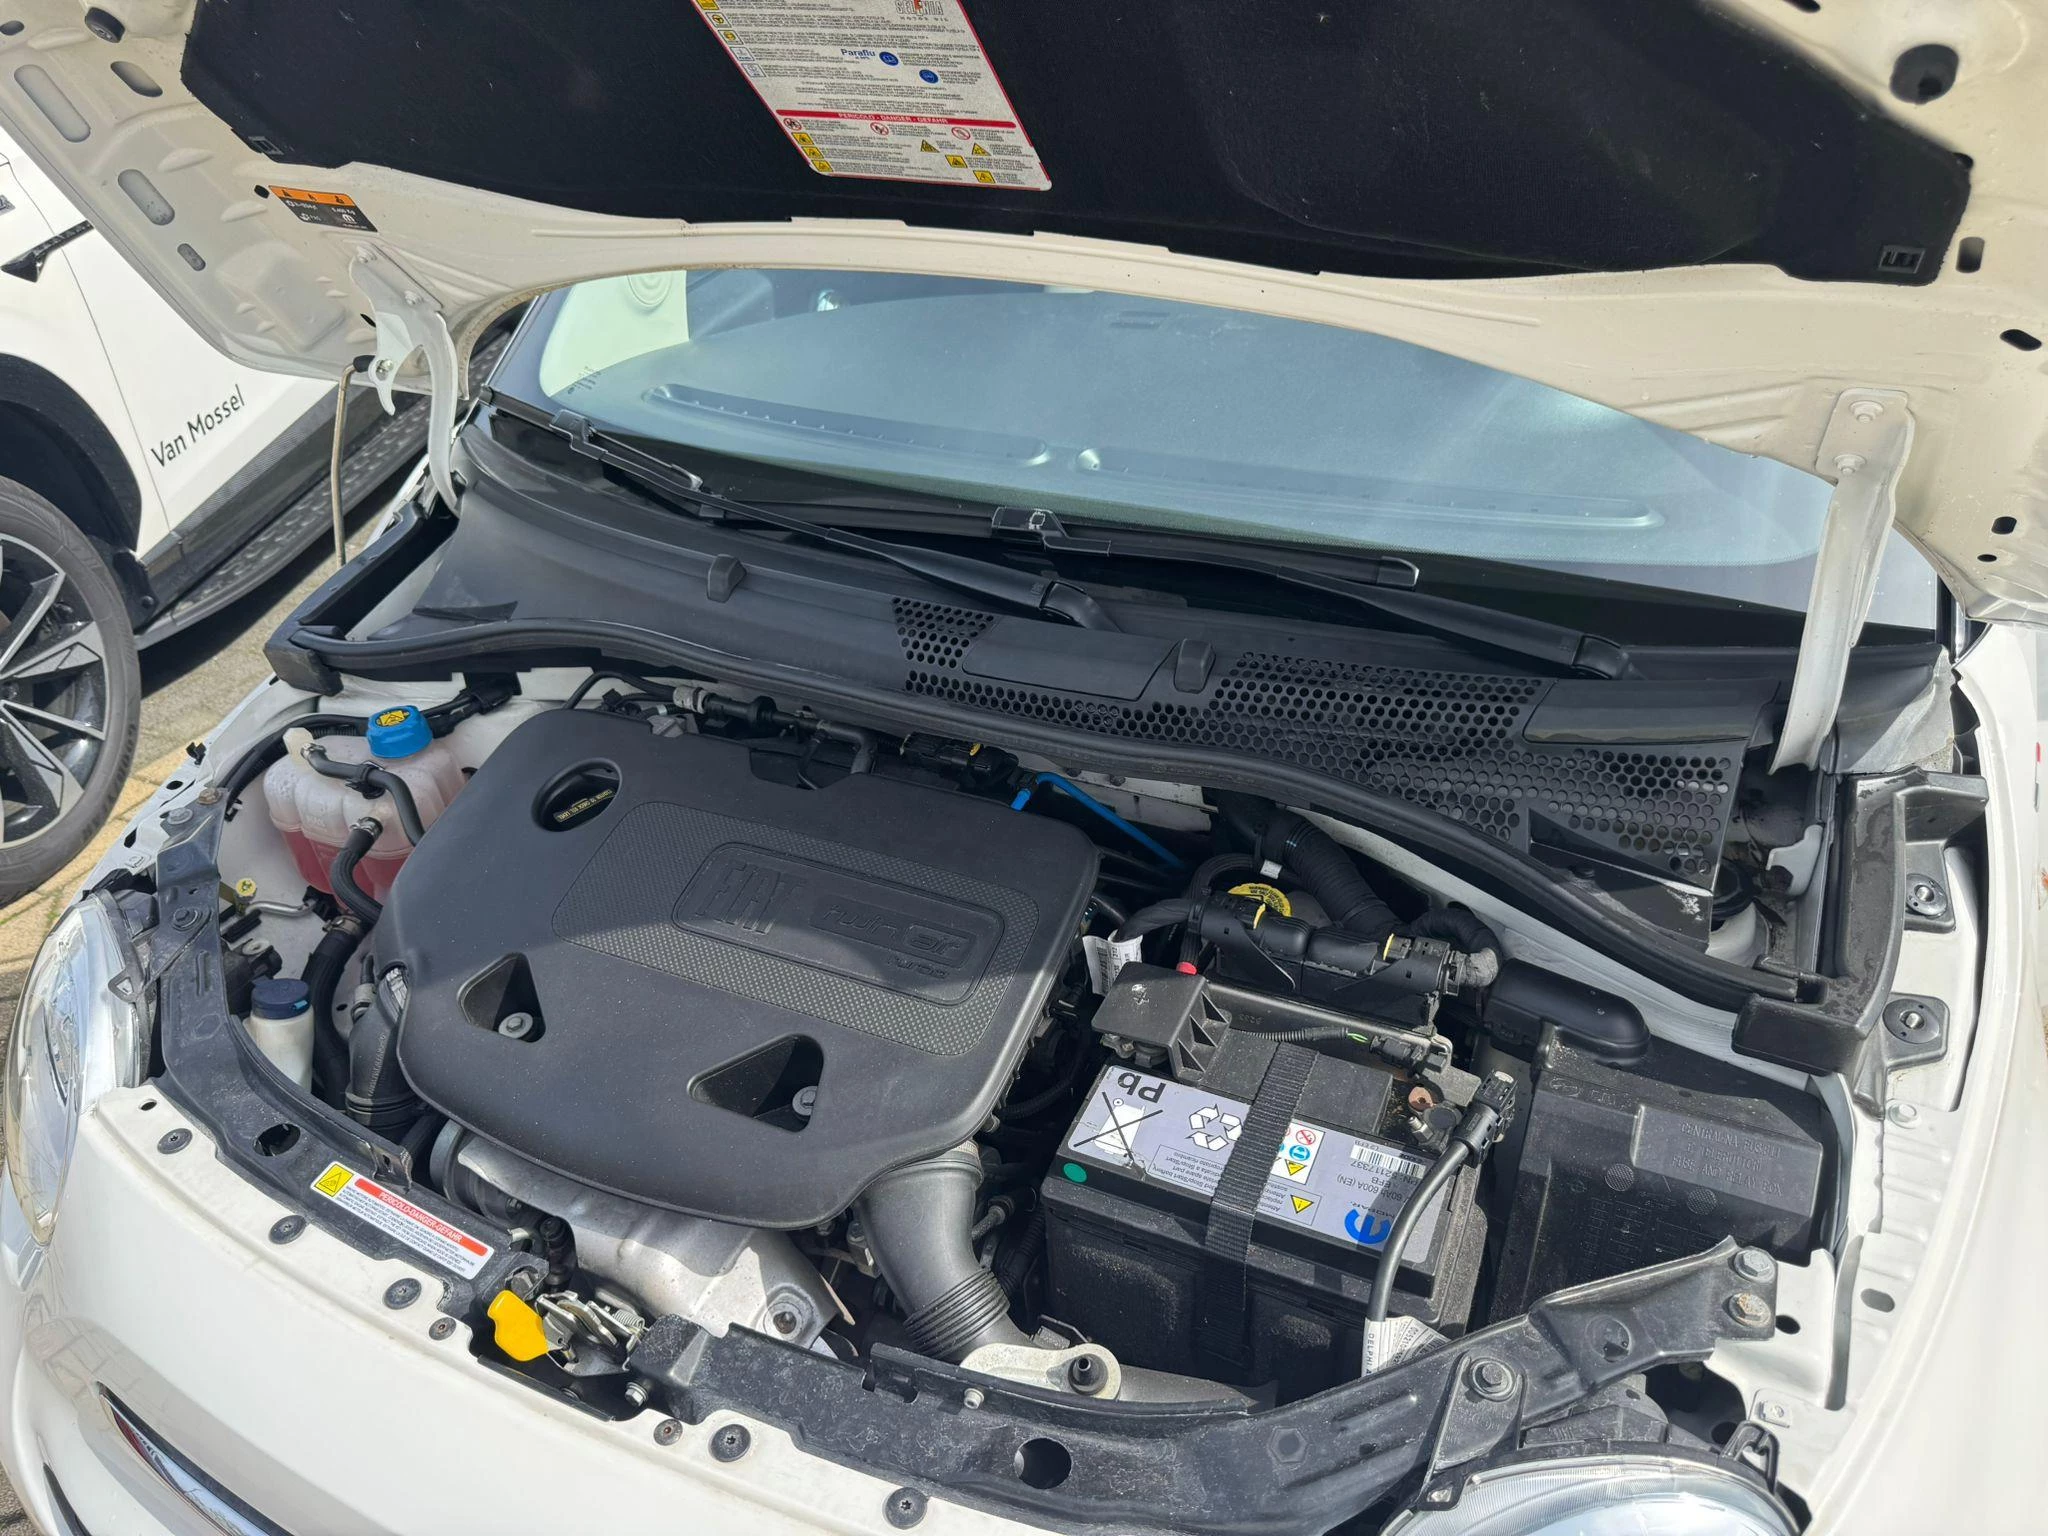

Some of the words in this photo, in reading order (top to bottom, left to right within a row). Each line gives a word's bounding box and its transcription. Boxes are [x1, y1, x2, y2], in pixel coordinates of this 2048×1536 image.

[840, 48, 876, 58] Paraflu
[838, 113, 876, 121] PERICOLO
[880, 115, 912, 123] DANGER
[917, 117, 949, 125] GEFAHR
[151, 434, 187, 467] Van
[187, 383, 245, 443] Mossel
[695, 859, 806, 935] FIAT
[1117, 1072, 1166, 1104] Pb
[1351, 1161, 1396, 1178] 52117337
[1672, 1155, 1697, 1173] FUSE
[1702, 1163, 1722, 1178] AND
[1726, 1170, 1757, 1189] RELAY
[1761, 1180, 1783, 1197] BOX
[1172, 1172, 1204, 1187] Stop/Start
[1337, 1173, 1356, 1186] (EN)
[1371, 1177, 1391, 1189] EFB
[1358, 1183, 1379, 1194] 600A
[1381, 1187, 1405, 1201] 60Ah
[1367, 1333, 1375, 1367] DELPHI
